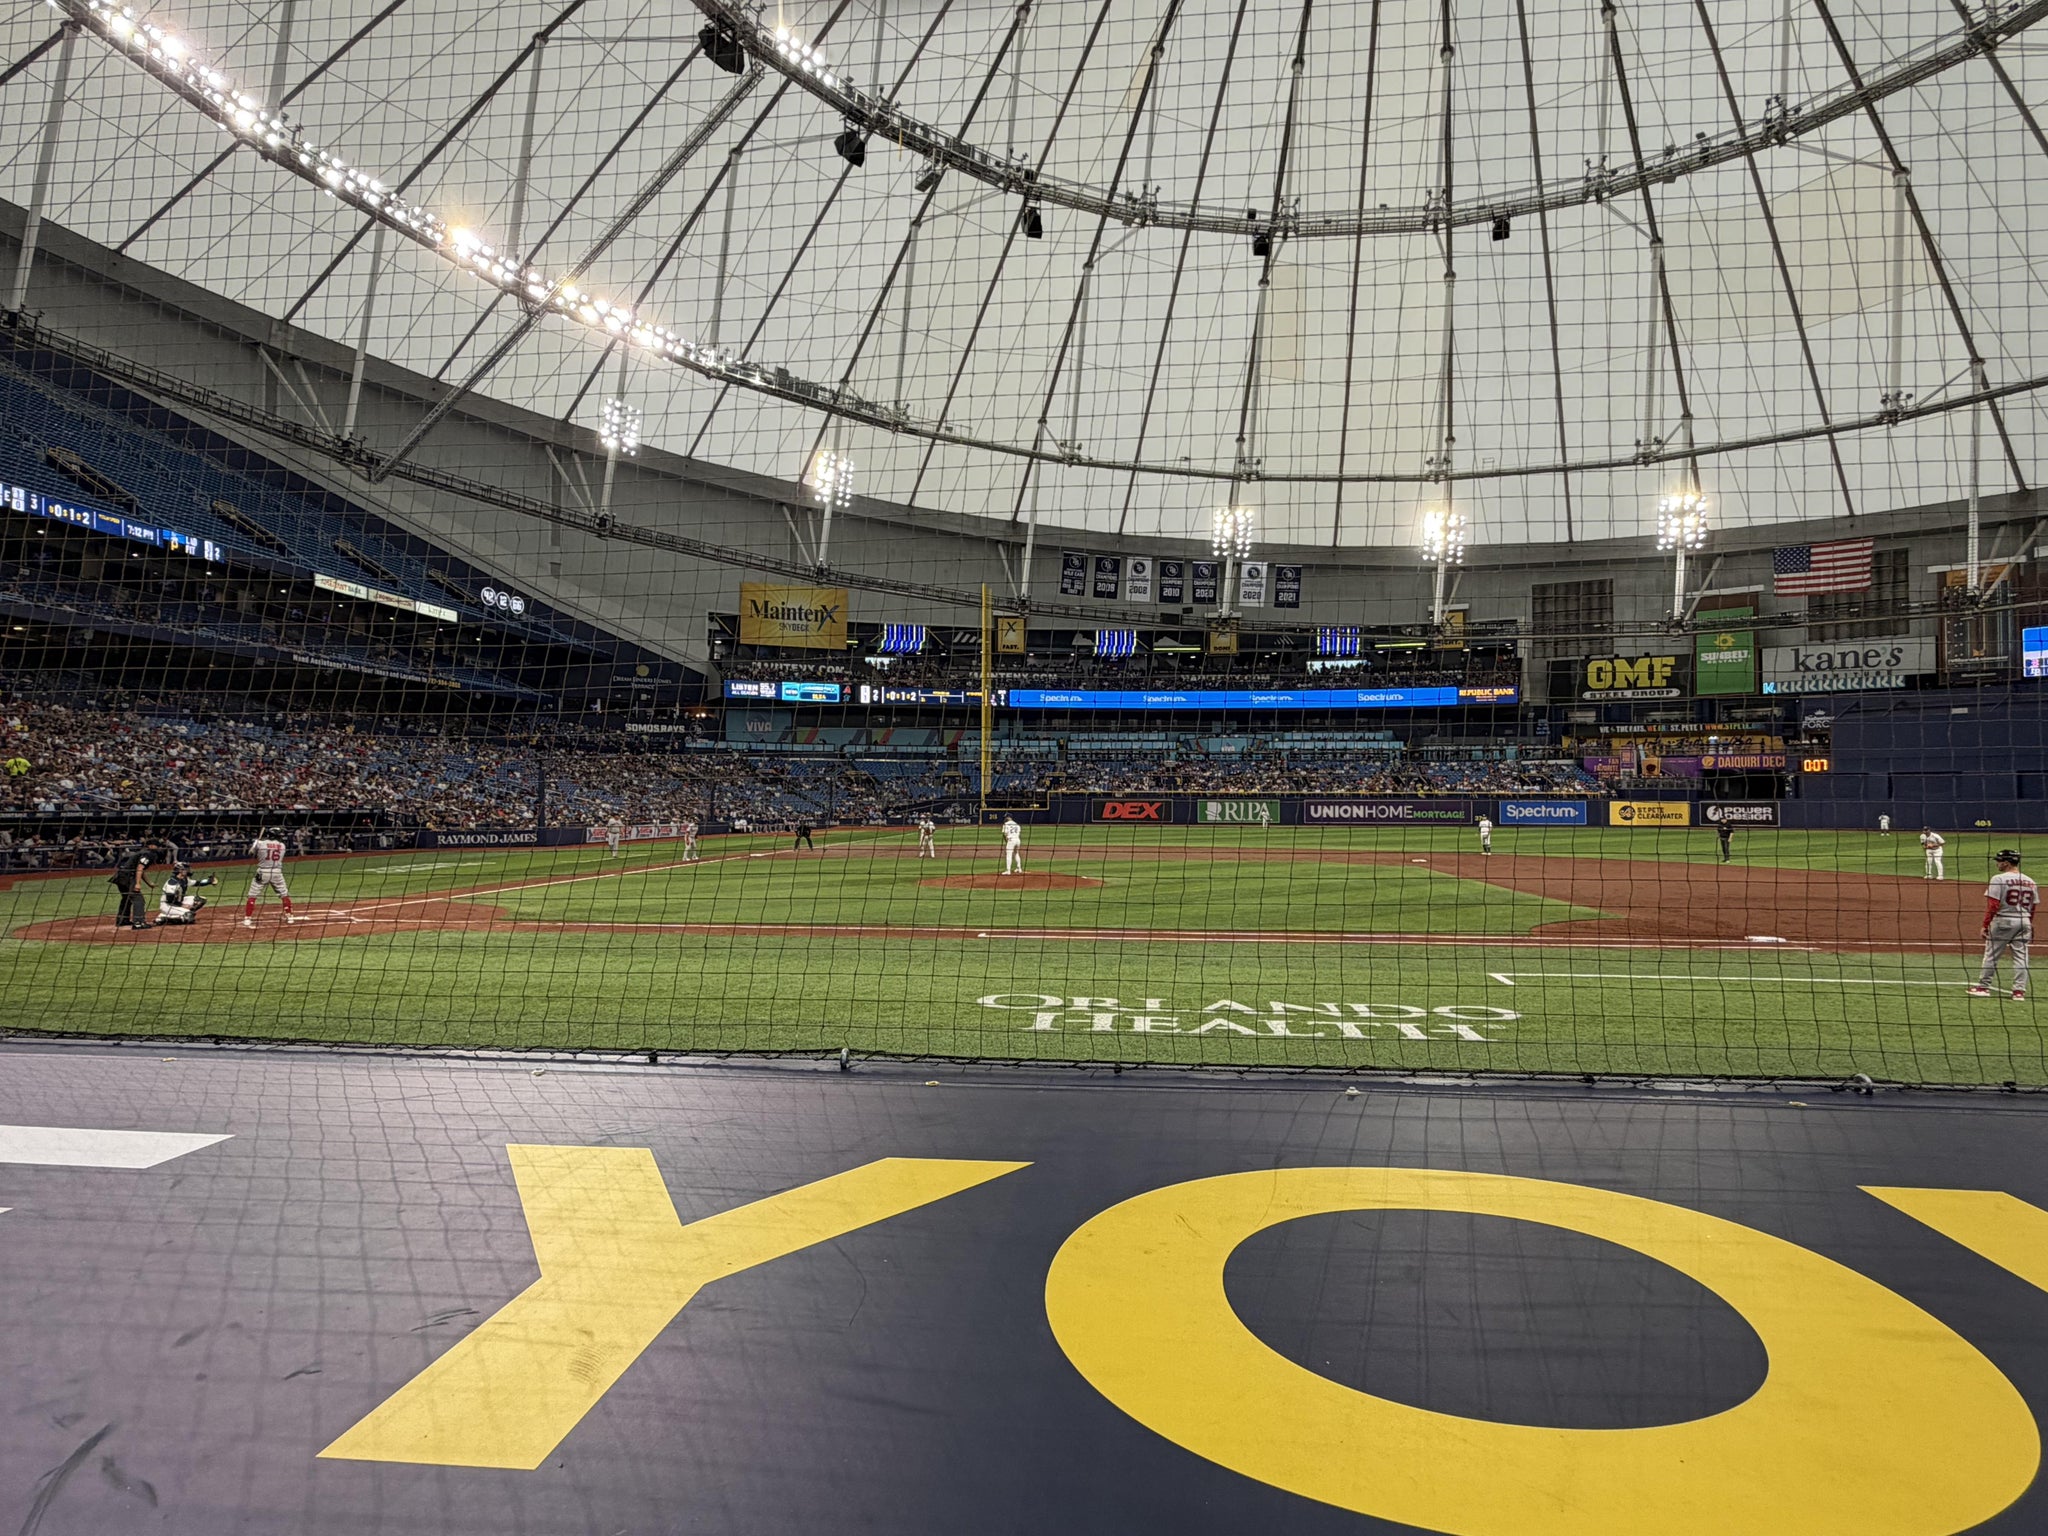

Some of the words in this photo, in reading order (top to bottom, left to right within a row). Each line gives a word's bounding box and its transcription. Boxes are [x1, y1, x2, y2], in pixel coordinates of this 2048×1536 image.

[1096, 582, 1115, 592] 2008
[1129, 585, 1147, 594] 2008
[1163, 588, 1180, 597] 2010
[1195, 589, 1214, 598] 2020
[1278, 592, 1296, 601] 2021
[749, 599, 841, 633] MaintenX
[779, 622, 809, 632] SKYDECK
[1700, 649, 1749, 662] SUNBELT
[1790, 646, 1904, 673] kane's
[1587, 656, 1676, 690] GMF
[731, 682, 759, 692] LISTEN
[1493, 688, 1514, 696] BANK
[1358, 692, 1400, 703] Spectrum
[1589, 690, 1628, 699] STEEL
[1631, 688, 1674, 697] GROUP
[746, 721, 772, 732] VIVA
[1681, 723, 1698, 732] PETE
[1718, 755, 1760, 768] DAIQUIRI
[1804, 759, 1828, 771] 0:07
[1102, 802, 1162, 819] DEX
[1506, 804, 1576, 820] Spectrum
[1637, 812, 1683, 820] CLEARWATER
[438, 834, 500, 845] RAYMOND
[500, 833, 538, 844] JAMES
[265, 850, 280, 861] 16
[977, 993, 1521, 1021] ORLANDO
[1018, 1012, 1499, 1042] HEALTH
